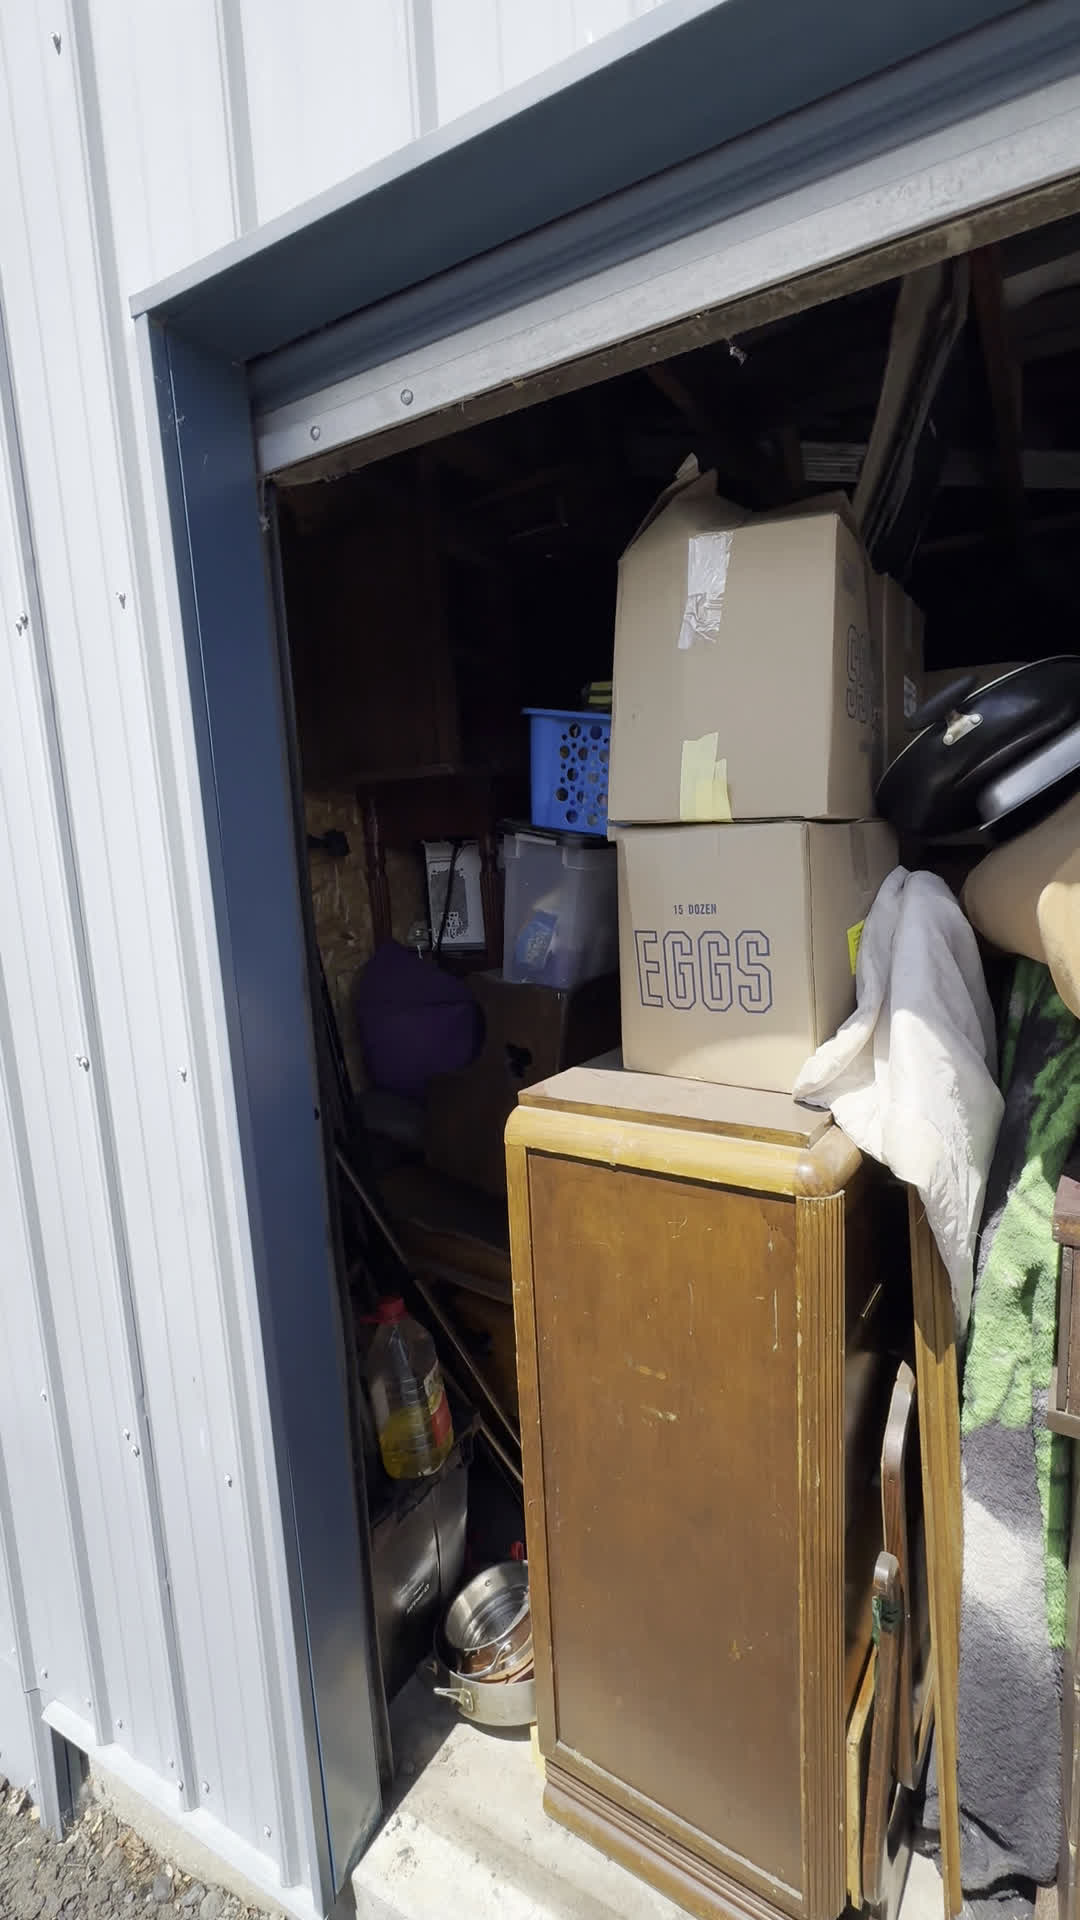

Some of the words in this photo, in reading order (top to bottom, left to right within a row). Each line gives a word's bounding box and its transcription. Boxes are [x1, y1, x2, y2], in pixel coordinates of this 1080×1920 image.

[673, 904, 684, 915] 15
[688, 904, 717, 915] DOZEN
[634, 930, 773, 1013] EGGS
